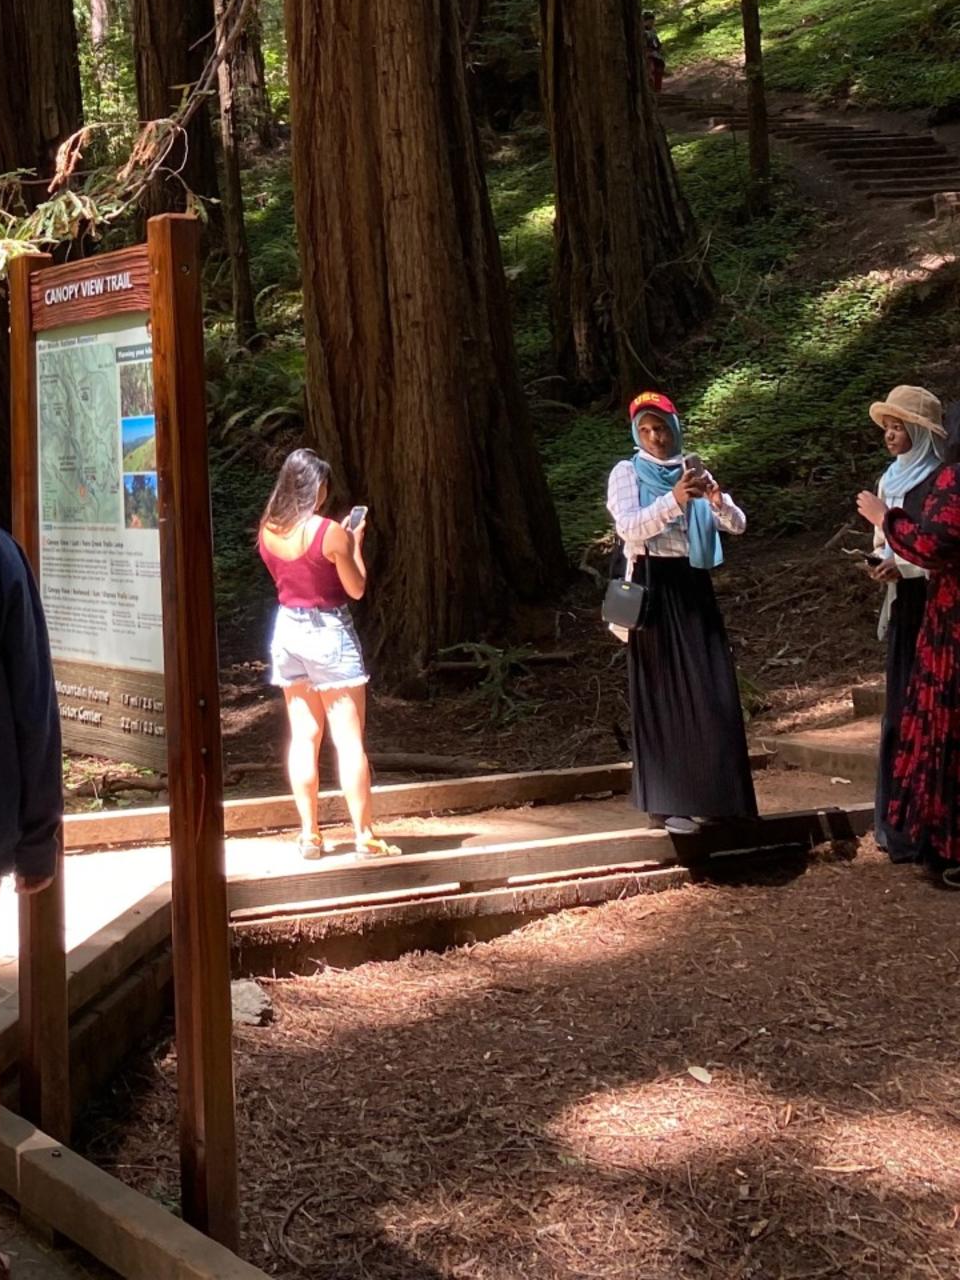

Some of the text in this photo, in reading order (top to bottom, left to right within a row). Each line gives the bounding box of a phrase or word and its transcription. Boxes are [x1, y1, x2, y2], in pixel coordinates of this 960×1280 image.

[45, 271, 133, 304] CANOPY VIEW TRAIL
[634, 392, 660, 405] USC
[55, 680, 87, 699] Mountain
[88, 685, 109, 703] Home
[78, 706, 102, 724] Center
